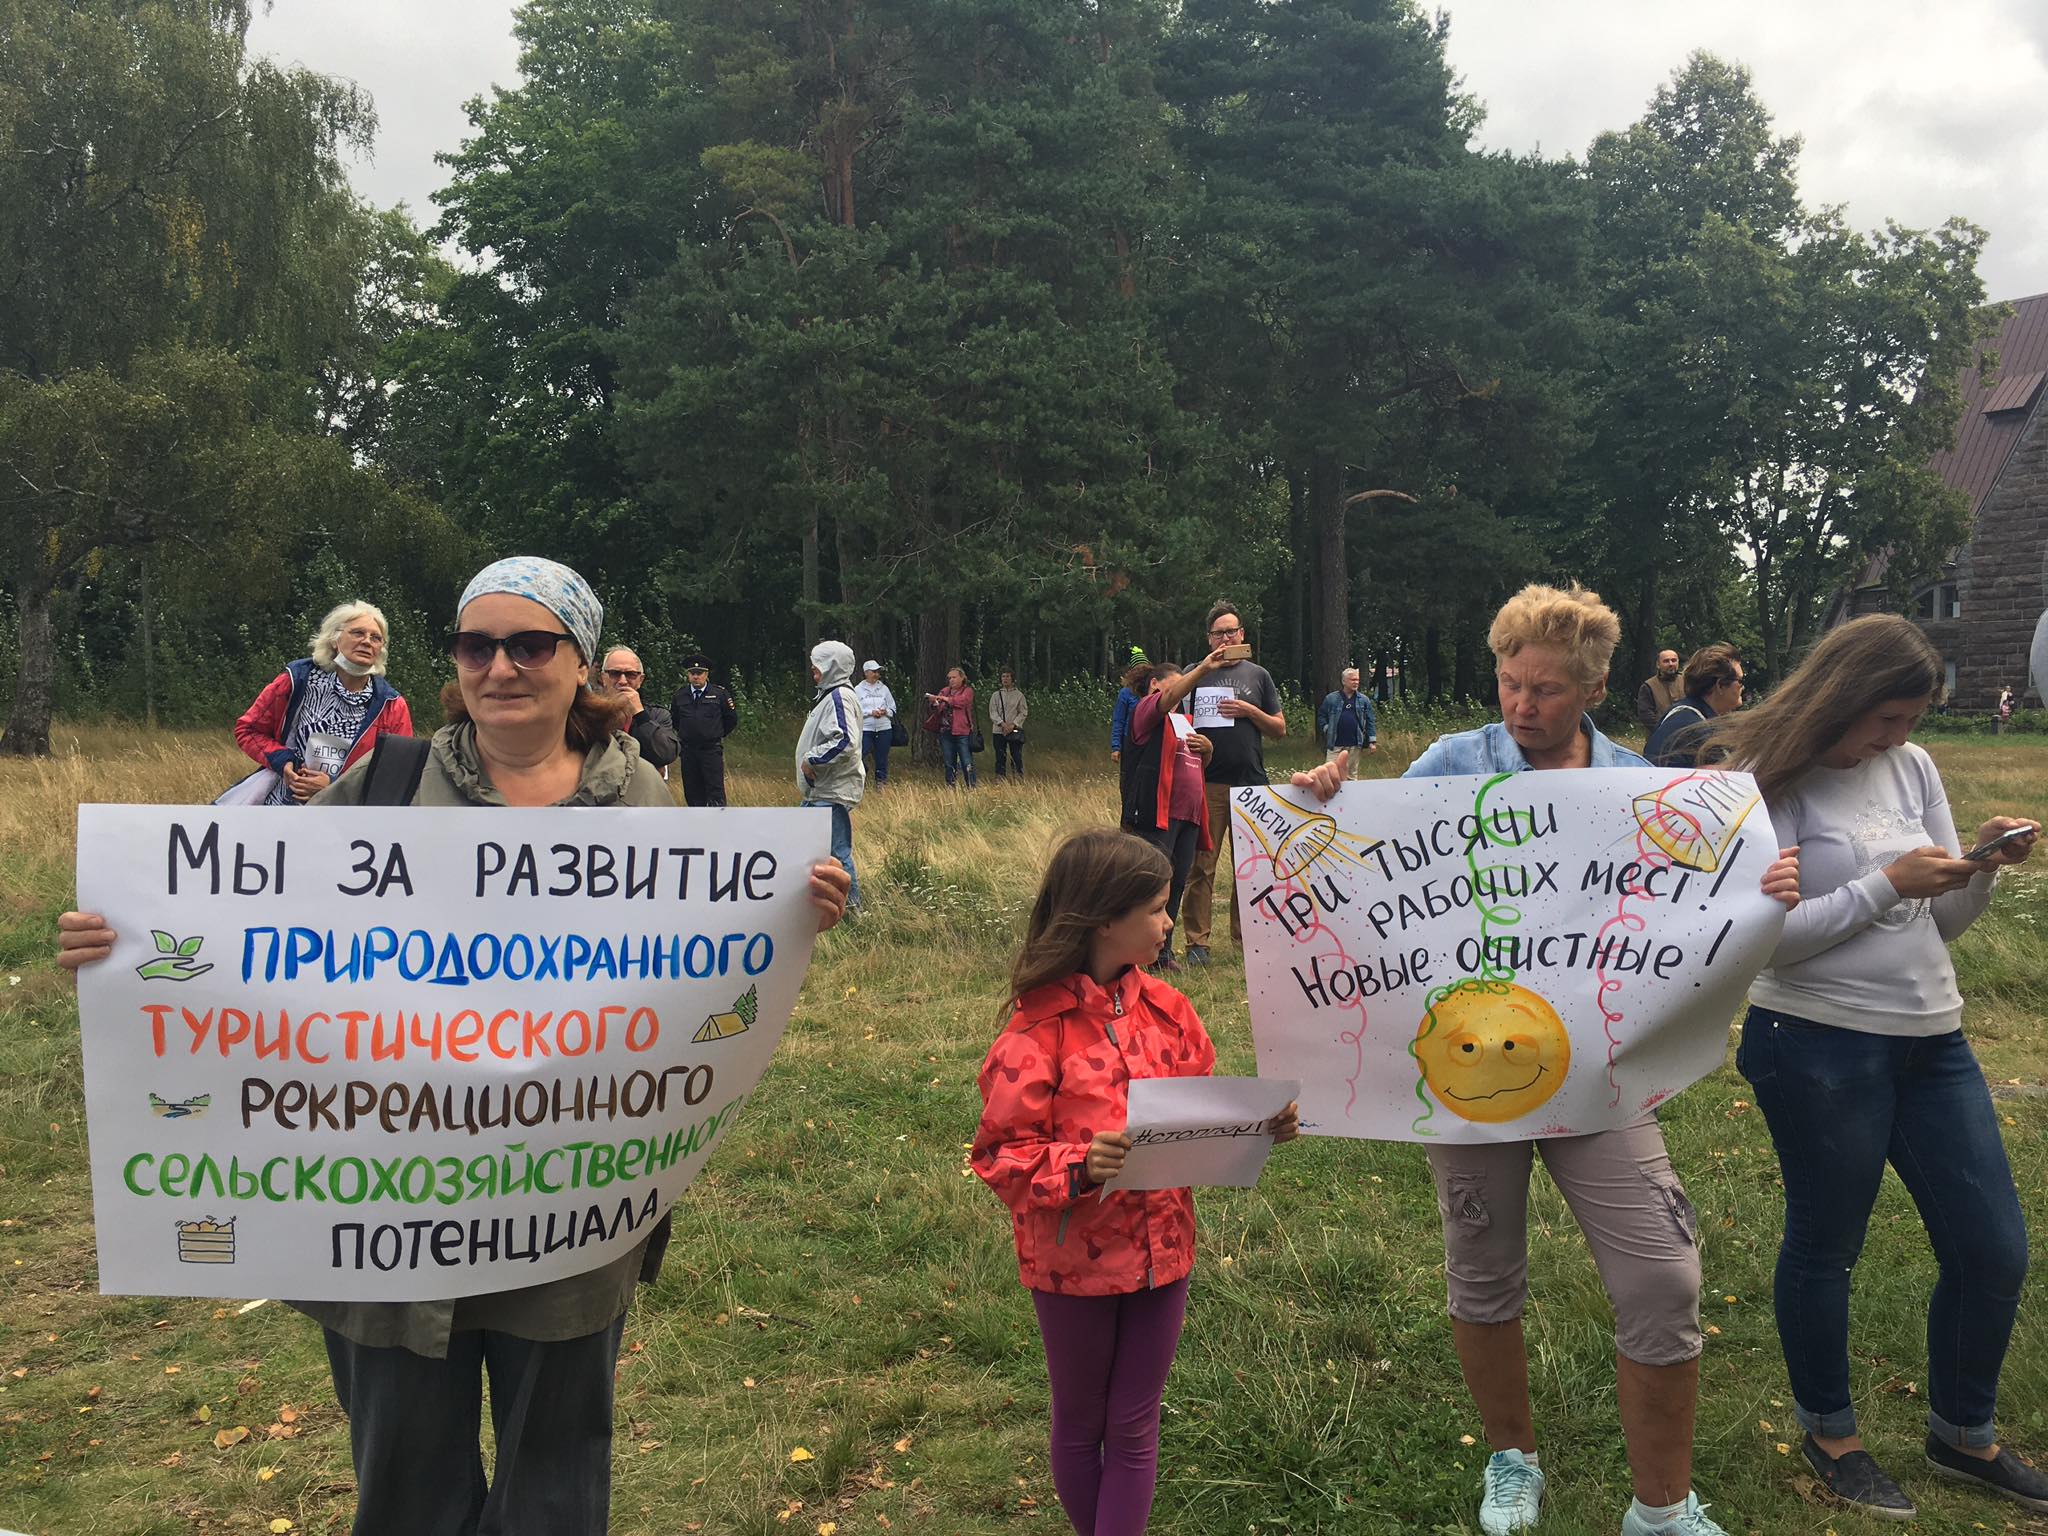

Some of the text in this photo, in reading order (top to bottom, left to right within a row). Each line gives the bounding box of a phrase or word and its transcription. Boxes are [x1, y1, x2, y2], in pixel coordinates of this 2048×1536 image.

[313, 744, 350, 760] #ПРО
[320, 762, 343, 775] ПО
[1236, 787, 1292, 841] ВЛАСТИ
[1682, 770, 1753, 826] УПК
[168, 822, 777, 902] МЫ ЗА РАЗВИТИЕ
[1249, 802, 1558, 937] ТРИ ТЫСЯЧИ
[1367, 861, 1560, 940] РАБОЧИХ
[241, 925, 774, 987] ПРИРОДООХРАННОГО
[1292, 947, 1430, 1010] НОВЫЕ
[141, 1003, 660, 1064] ТУРИСТИЧЕСКОГО
[240, 1064, 714, 1136] РЕКРЕАЦИОННОГО
